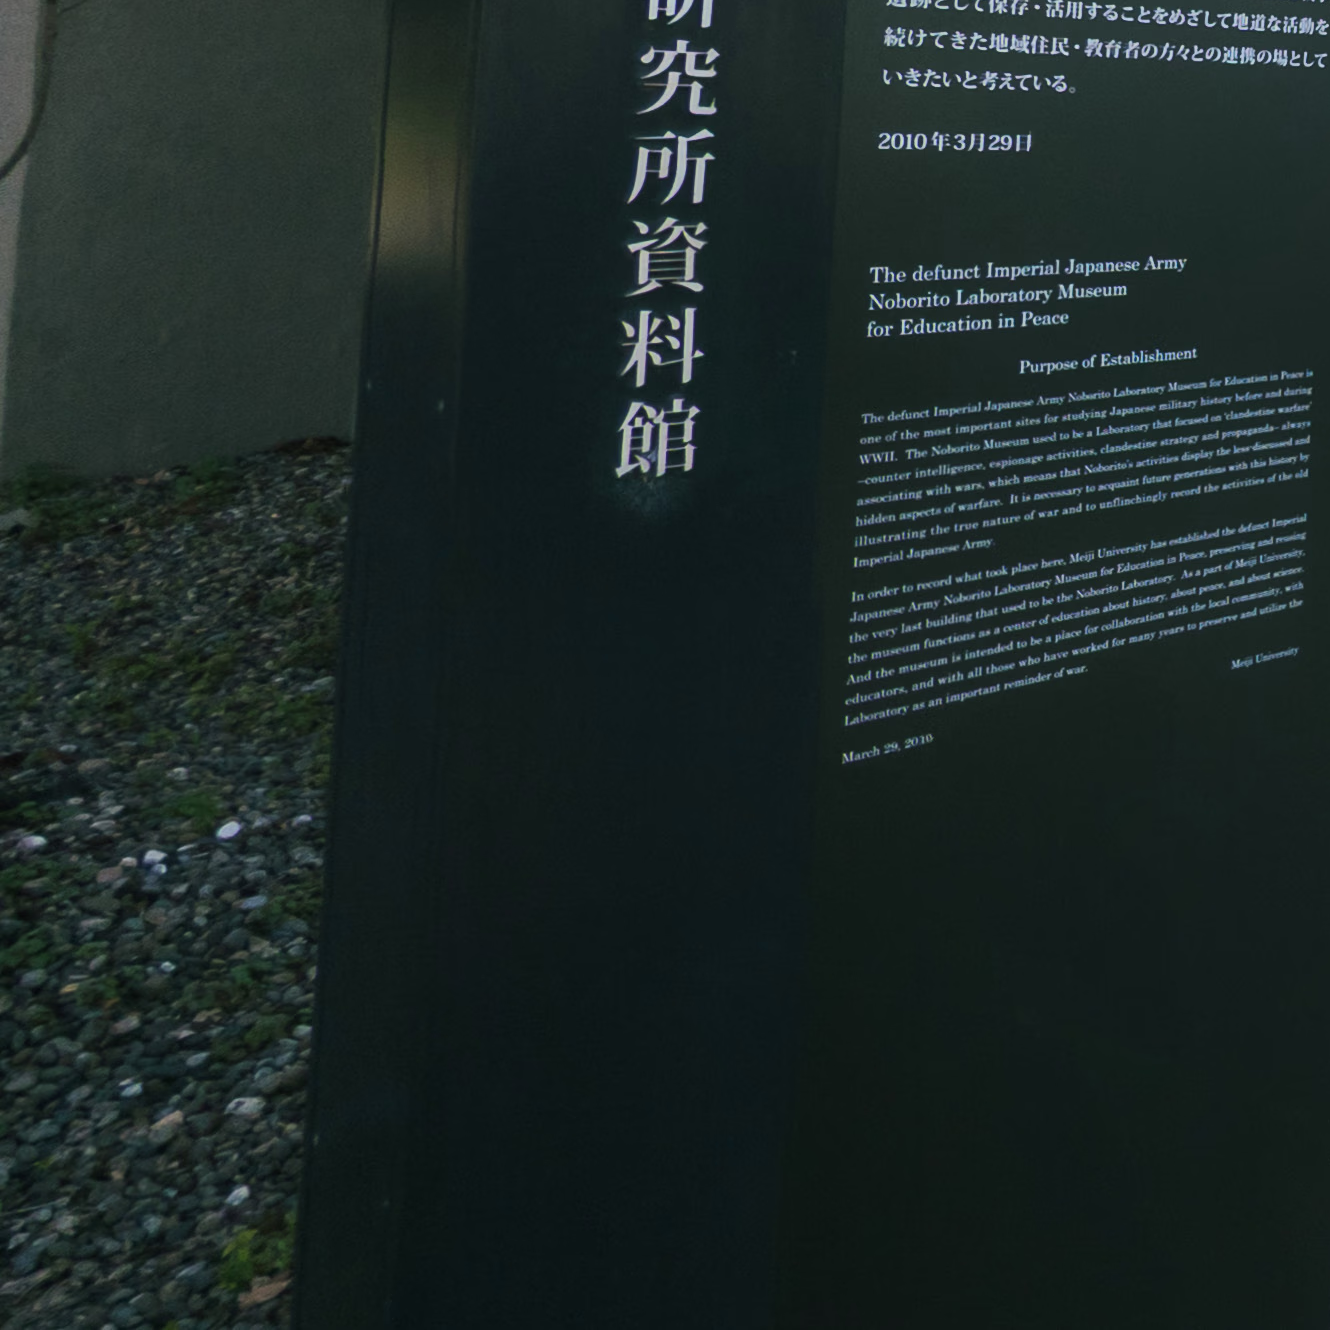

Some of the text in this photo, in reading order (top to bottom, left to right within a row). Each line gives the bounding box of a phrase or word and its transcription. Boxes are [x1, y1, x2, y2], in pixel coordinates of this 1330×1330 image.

[883, 26, 1327, 68] 続けてきた地域住民・教育者の方々との連携の場として
[882, 67, 1076, 93] いきたいと考えている。
[877, 130, 1032, 152] 2010年3月29日
[869, 255, 1187, 283] The defunct Imperial Japanese Army
[868, 283, 1127, 310] Noborito Laboratory Museum
[866, 310, 1069, 337] for Education in Peace
[1019, 347, 1197, 375] Purpose of Establishment
[859, 408, 1107, 444] one of the most important sites for studying
[860, 412, 884, 424] The
[886, 409, 929, 421] defunct
[933, 401, 981, 417] Imperial
[983, 399, 1033, 412] Japanese
[1036, 395, 1064, 405] Army
[905, 447, 928, 459] The
[930, 441, 980, 456] Noborito
[982, 437, 1029, 450] Museum
[1032, 431, 1056, 444] used
[1059, 432, 1069, 440] to
[1071, 429, 1083, 439] be
[988, 454, 1043, 469] espionage
[856, 489, 922, 506] associating
[925, 483, 951, 496] with
[988, 473, 1020, 487] which
[1022, 471, 1057, 483] means
[1059, 467, 1080, 478] that
[855, 512, 896, 526] hidden
[898, 506, 941, 521] aspects
[943, 502, 955, 513] of
[1009, 493, 1018, 504] It
[1021, 492, 1031, 502] is
[1033, 486, 1082, 500] necessary
[1085, 484, 1095, 493] to
[854, 502, 1096, 547] illustrating the true nature of war and to
[852, 549, 903, 568] Imperial
[905, 543, 960, 559] Japanese
[851, 590, 864, 602] In
[866, 585, 898, 599] order
[901, 584, 913, 593] to
[916, 574, 952, 591] record
[954, 570, 982, 583] what
[985, 564, 1008, 578] took
[1010, 562, 1038, 576] place
[1068, 550, 1094, 564] Meiji
[848, 570, 1097, 622] Japanese Army Noborito Laboratory Museum
[848, 592, 1073, 643] the very last building that used to be the
[847, 652, 867, 664] the
[870, 642, 920, 660] museum
[923, 631, 975, 649] functions
[978, 628, 990, 638] as
[993, 626, 1000, 635] a
[1002, 619, 1036, 632] center
[1038, 613, 1050, 625] of
[845, 669, 872, 685] And
[874, 666, 894, 679] the
[898, 656, 948, 674] museum
[951, 652, 961, 663] is
[964, 640, 1013, 660] intended
[1016, 640, 1027, 649] to
[1029, 636, 1042, 646] be
[1044, 635, 1051, 643] a
[1054, 629, 1081, 643] place
[911, 676, 934, 691] and
[937, 670, 964, 685] with
[966, 665, 982, 679] all
[985, 662, 1015, 674] those
[1018, 655, 1040, 667] who
[1042, 650, 1068, 662] have
[844, 704, 908, 726] Laboratory
[911, 701, 925, 711] as
[927, 697, 942, 707] an
[945, 683, 1000, 703] important
[1003, 671, 1051, 690] reminder
[1053, 666, 1064, 678] of
[841, 745, 880, 764] March
